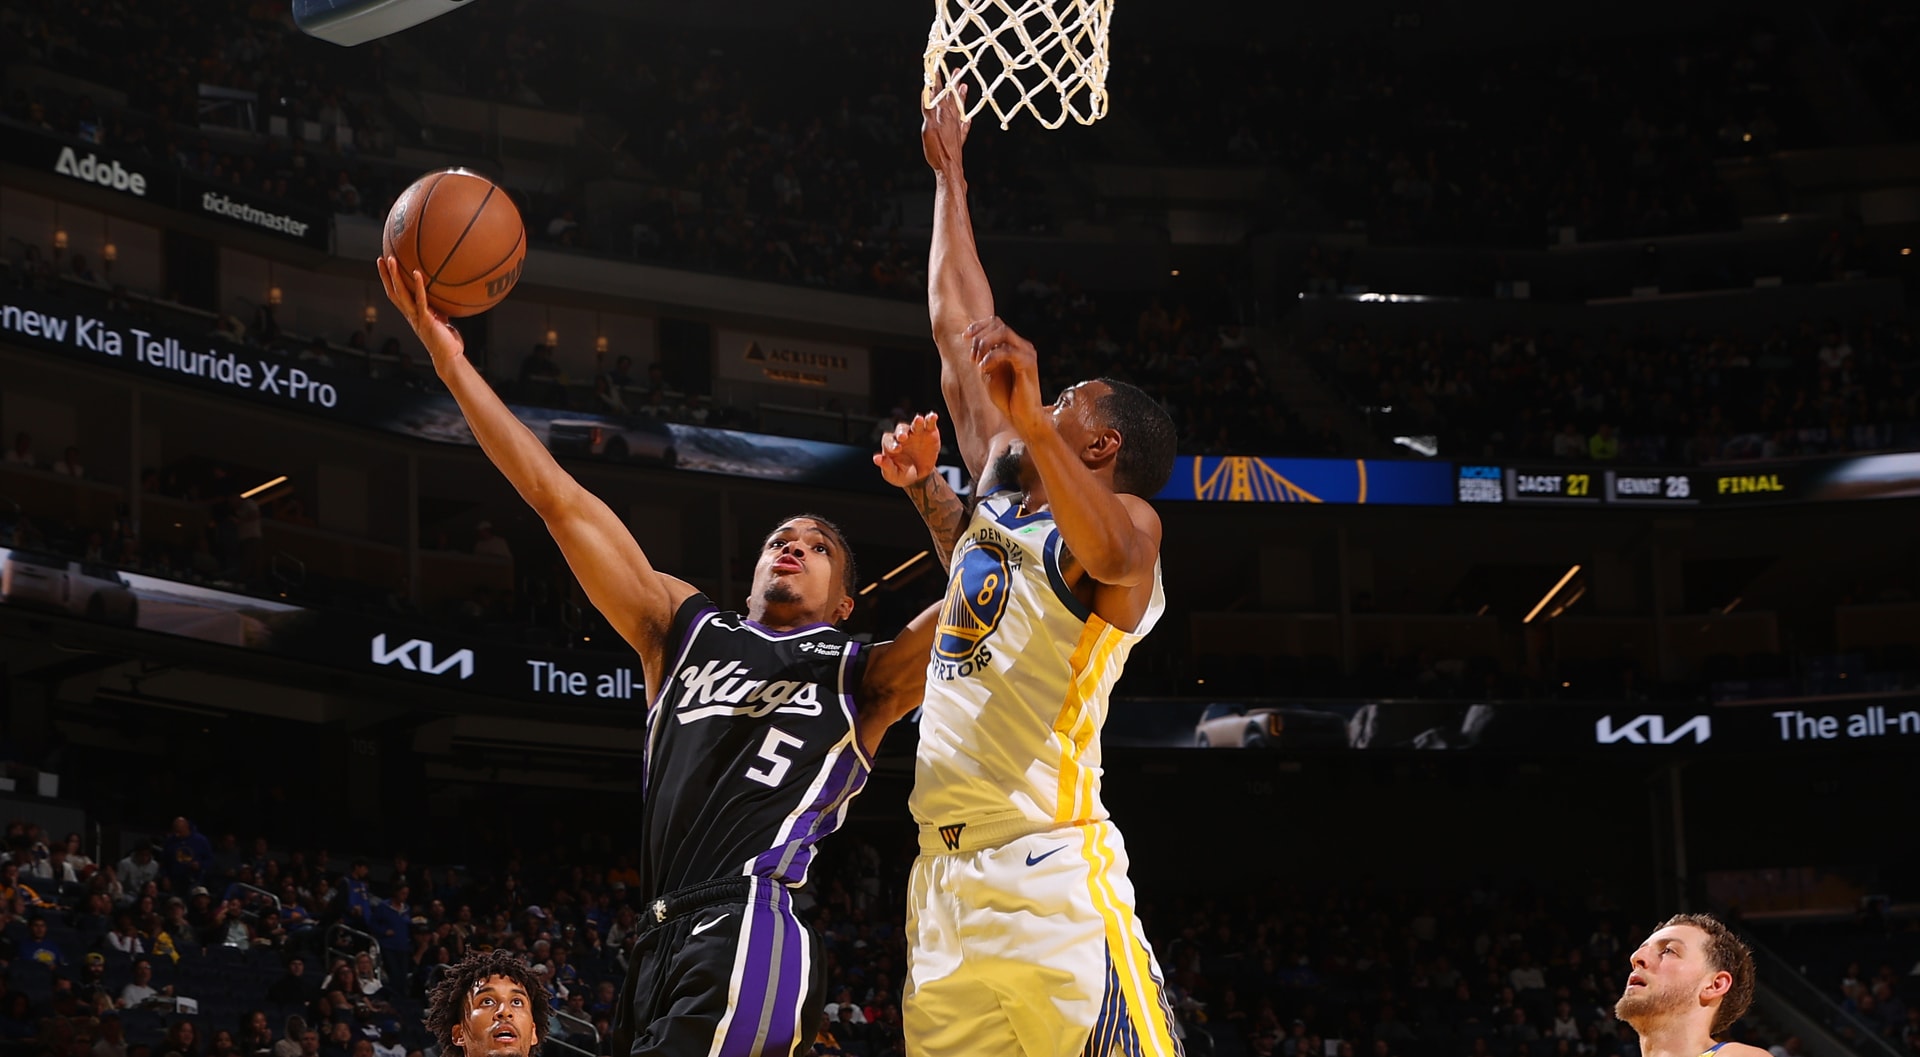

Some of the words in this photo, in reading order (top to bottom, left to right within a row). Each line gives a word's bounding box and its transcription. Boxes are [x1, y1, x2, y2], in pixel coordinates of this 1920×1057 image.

[55, 146, 147, 196] Adobe
[202, 191, 309, 237] ticketmaster
[0, 304, 68, 342] new
[75, 315, 123, 357] Kia
[130, 329, 252, 388] Telluride
[259, 361, 338, 409] X-Pro
[1459, 488, 1503, 503] SCORES
[1517, 475, 1562, 493] JACST
[1566, 474, 1590, 497] 27
[1616, 478, 1661, 495] KENNST
[1665, 475, 1691, 498] 26
[1717, 474, 1785, 495] FINAL
[1005, 537, 1024, 573] STATE
[976, 573, 999, 606] 8
[813, 647, 840, 657] Health
[817, 641, 843, 651] Sutter
[527, 660, 588, 696] The
[596, 668, 644, 699] all-
[677, 660, 822, 722] Kings
[1773, 710, 1839, 741] The
[351, 737, 377, 757] 105
[745, 726, 806, 788] 5
